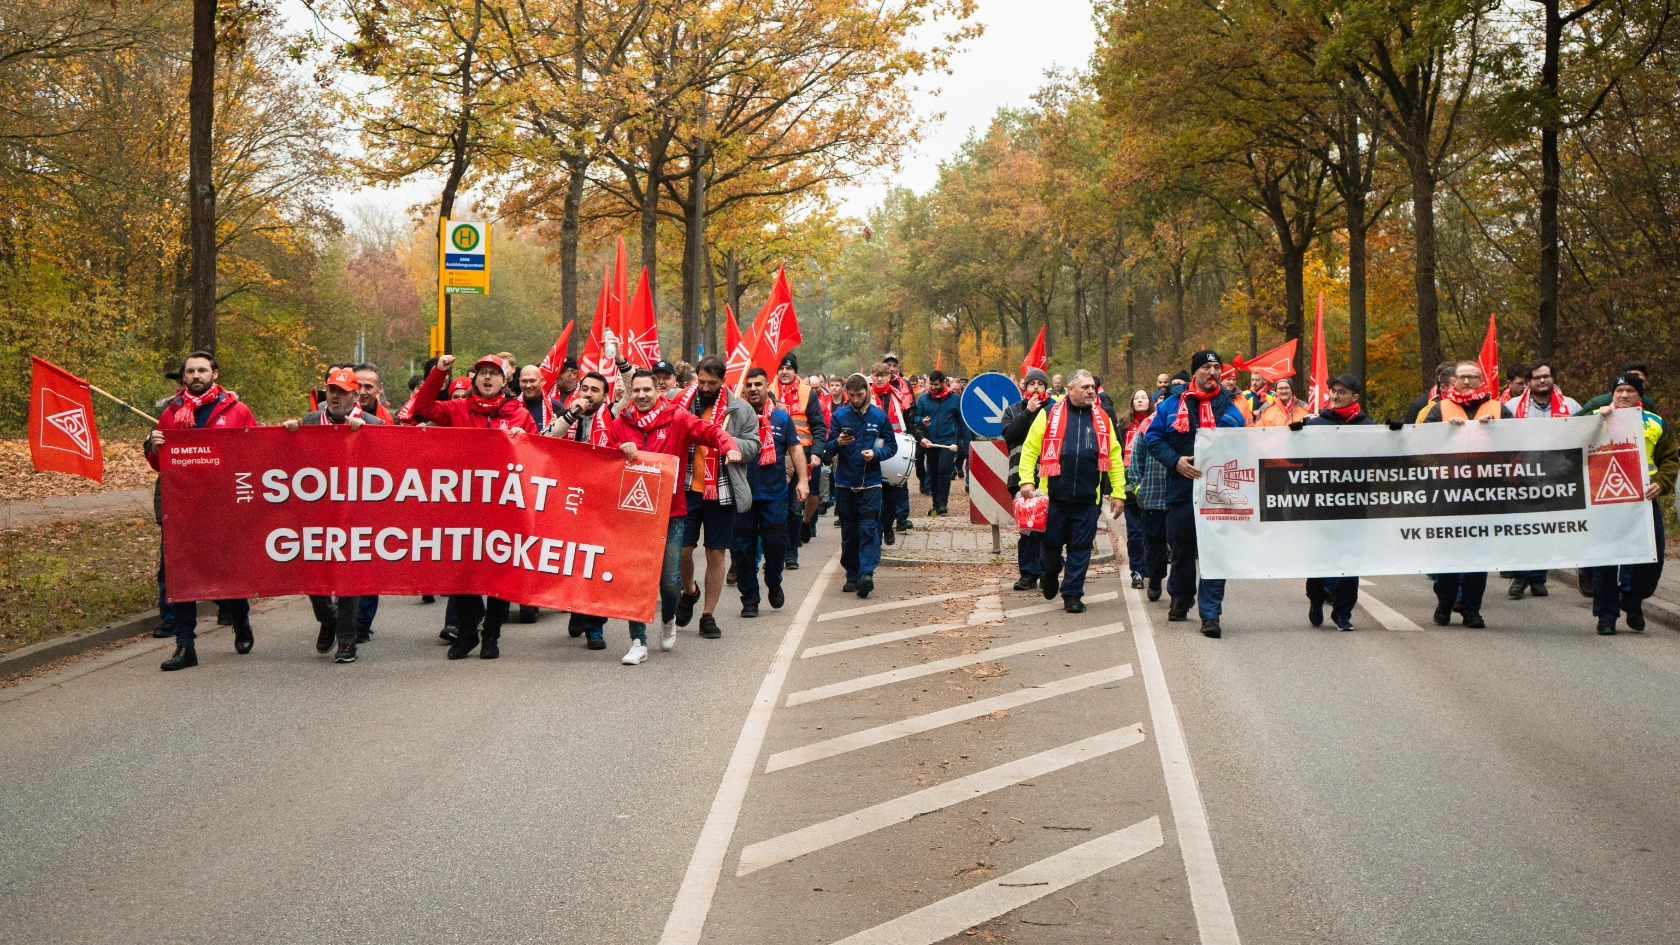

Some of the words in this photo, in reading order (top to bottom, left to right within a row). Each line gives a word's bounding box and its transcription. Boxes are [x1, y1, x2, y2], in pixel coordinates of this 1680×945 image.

[460, 230, 471, 245] H
[171, 447, 180, 455] IG
[181, 446, 212, 455] METALL
[171, 457, 220, 466] Regensburg
[1287, 466, 1449, 484] VERTRAUENSLEUTE
[1454, 464, 1472, 479] IG
[1477, 462, 1546, 478] METALL
[235, 472, 254, 503] Mit
[261, 463, 558, 512] SOLIDARITÄT
[1266, 493, 1310, 508] BMW
[1314, 490, 1427, 507] REGENSBURG
[1431, 489, 1440, 503] /
[1443, 482, 1577, 503] WACKERSDORF
[565, 486, 584, 515] für
[1400, 528, 1422, 540] VK
[1426, 525, 1489, 539] BEREICH
[1493, 520, 1588, 537] PRESSWERK
[265, 526, 614, 583] GERECHTIGKEIT.
